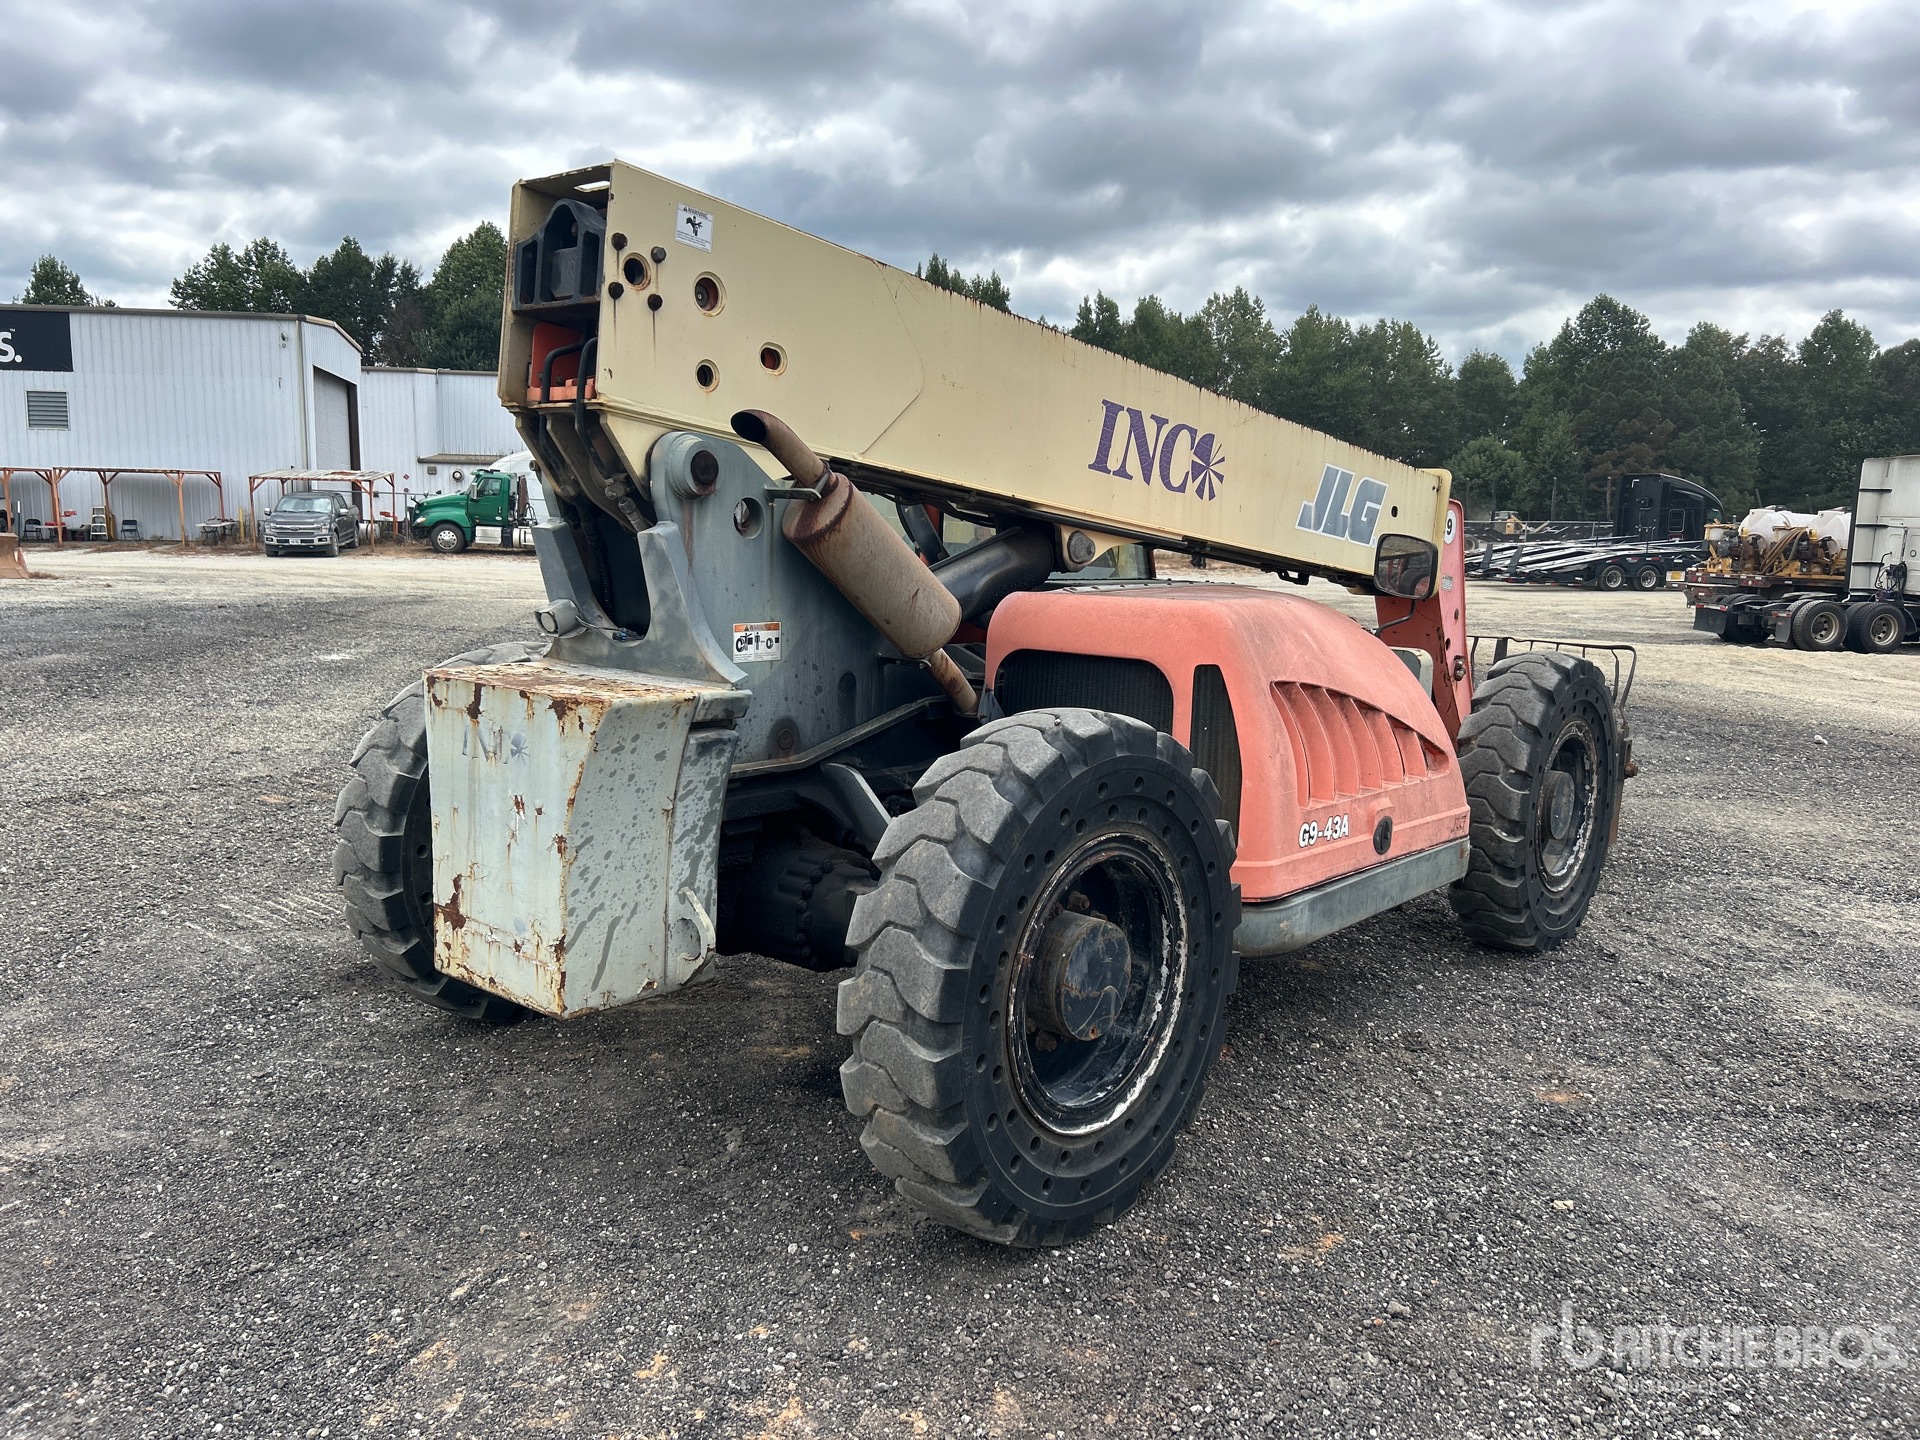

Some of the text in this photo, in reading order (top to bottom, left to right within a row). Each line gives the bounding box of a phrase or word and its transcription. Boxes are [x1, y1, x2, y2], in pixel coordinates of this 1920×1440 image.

[1294, 462, 1389, 547] JLG
[1446, 518, 1453, 536] 9
[1298, 813, 1349, 848] G9-43A
